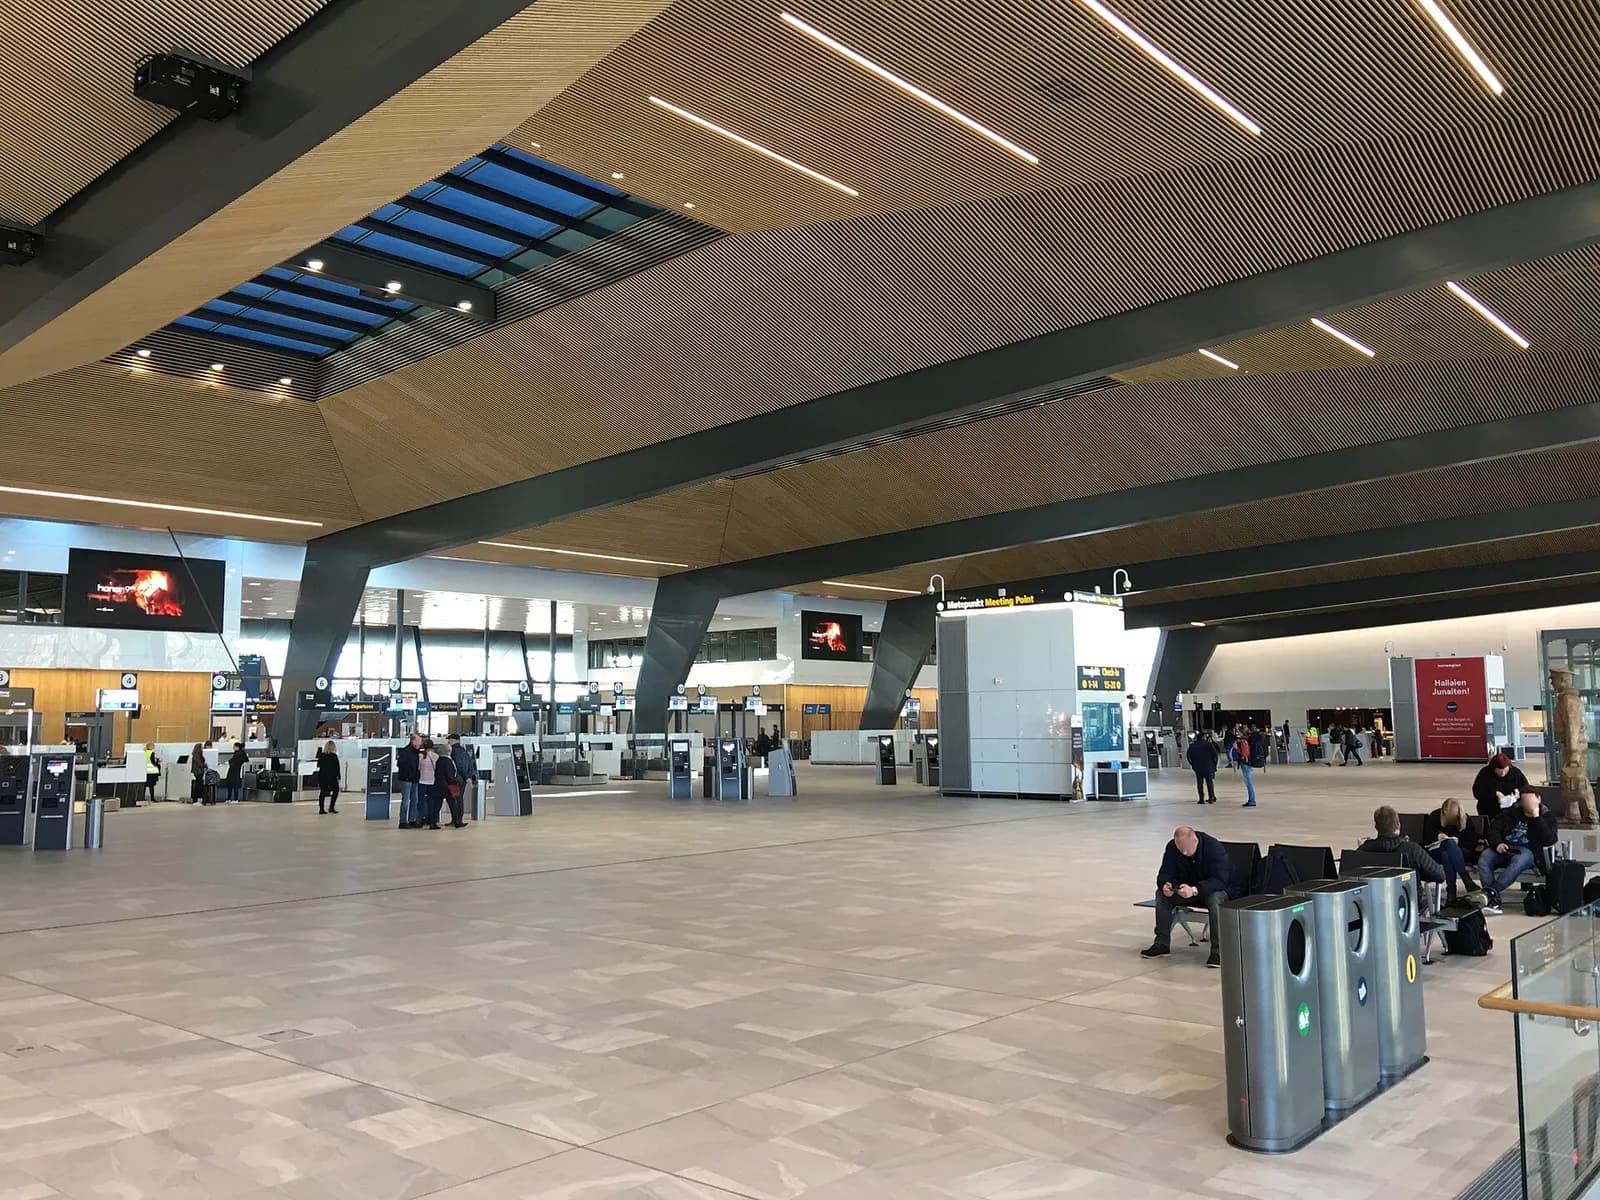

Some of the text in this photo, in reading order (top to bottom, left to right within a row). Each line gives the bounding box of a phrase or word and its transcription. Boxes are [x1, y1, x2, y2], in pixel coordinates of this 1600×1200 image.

[985, 597, 1014, 608] Meeting
[1015, 595, 1034, 604] Point
[1434, 679, 1466, 687] Hallaien
[1432, 687, 1470, 696] Junaiten!
